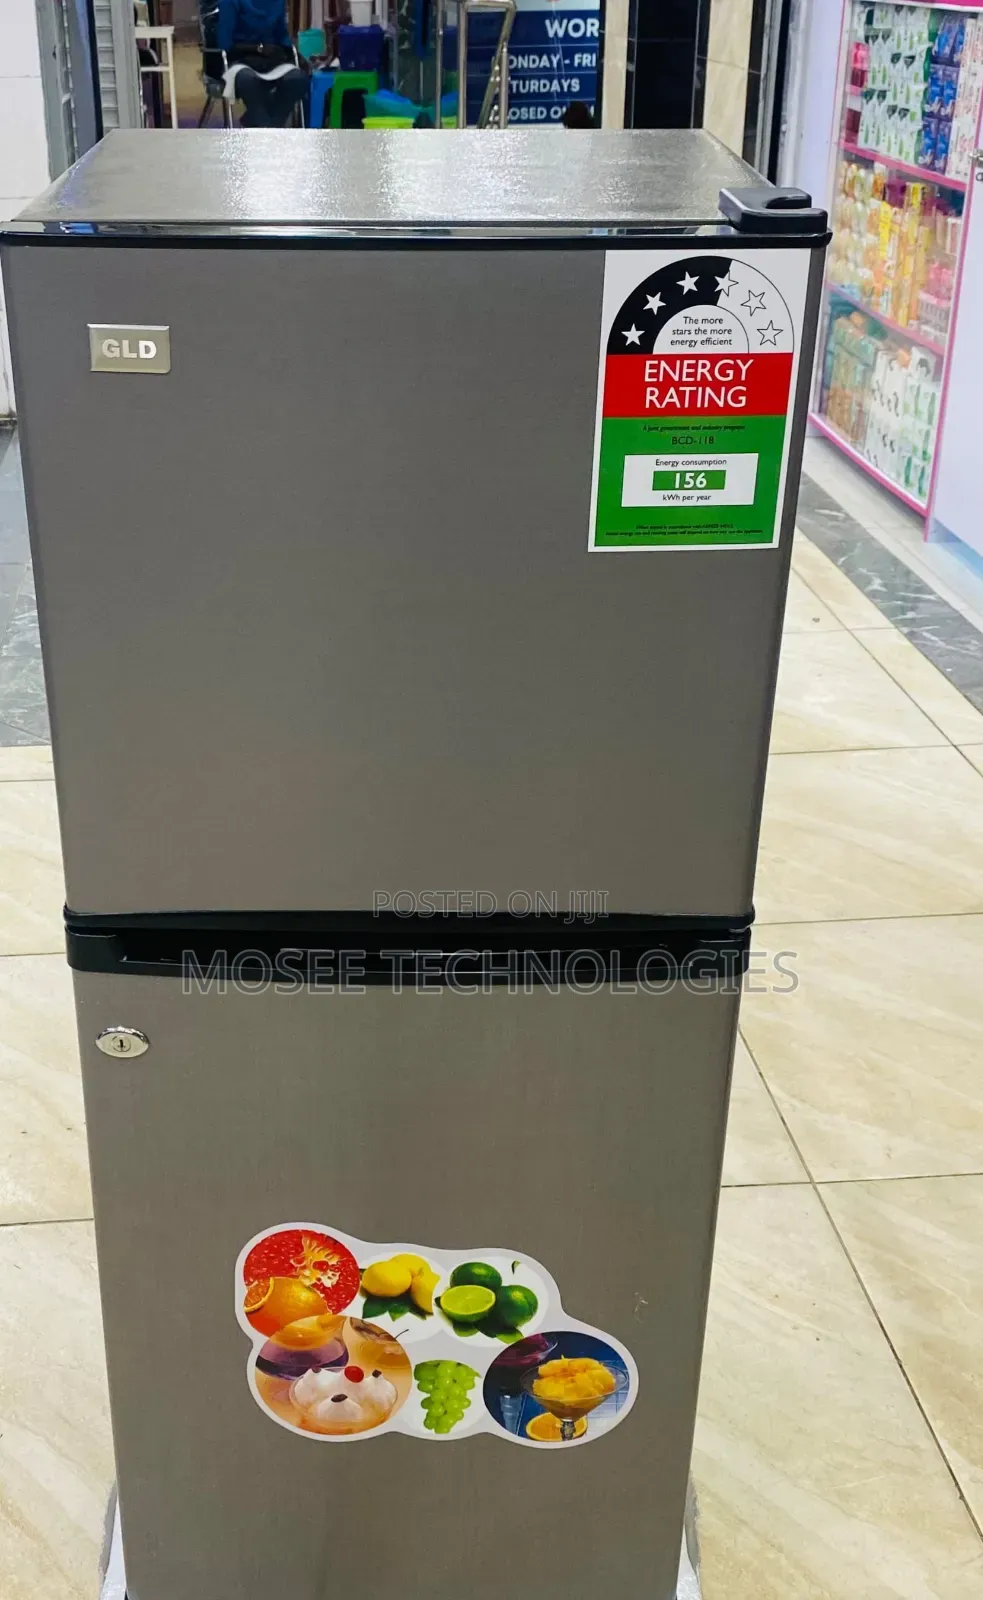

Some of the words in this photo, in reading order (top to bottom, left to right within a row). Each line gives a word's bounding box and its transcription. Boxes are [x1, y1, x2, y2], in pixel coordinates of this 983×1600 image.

[507, 53, 560, 69] ONDAY
[574, 53, 597, 67] FRI
[507, 77, 580, 93] TURDAYS
[506, 106, 547, 120] OSED
[682, 316, 699, 324] The
[694, 327, 708, 335] the
[101, 338, 157, 359] GLD
[670, 339, 698, 348] energy
[700, 337, 733, 346] efficient
[644, 359, 754, 382] ENERGY
[645, 386, 747, 408] RATING
[655, 459, 680, 467] Energy
[674, 472, 707, 489] 156
